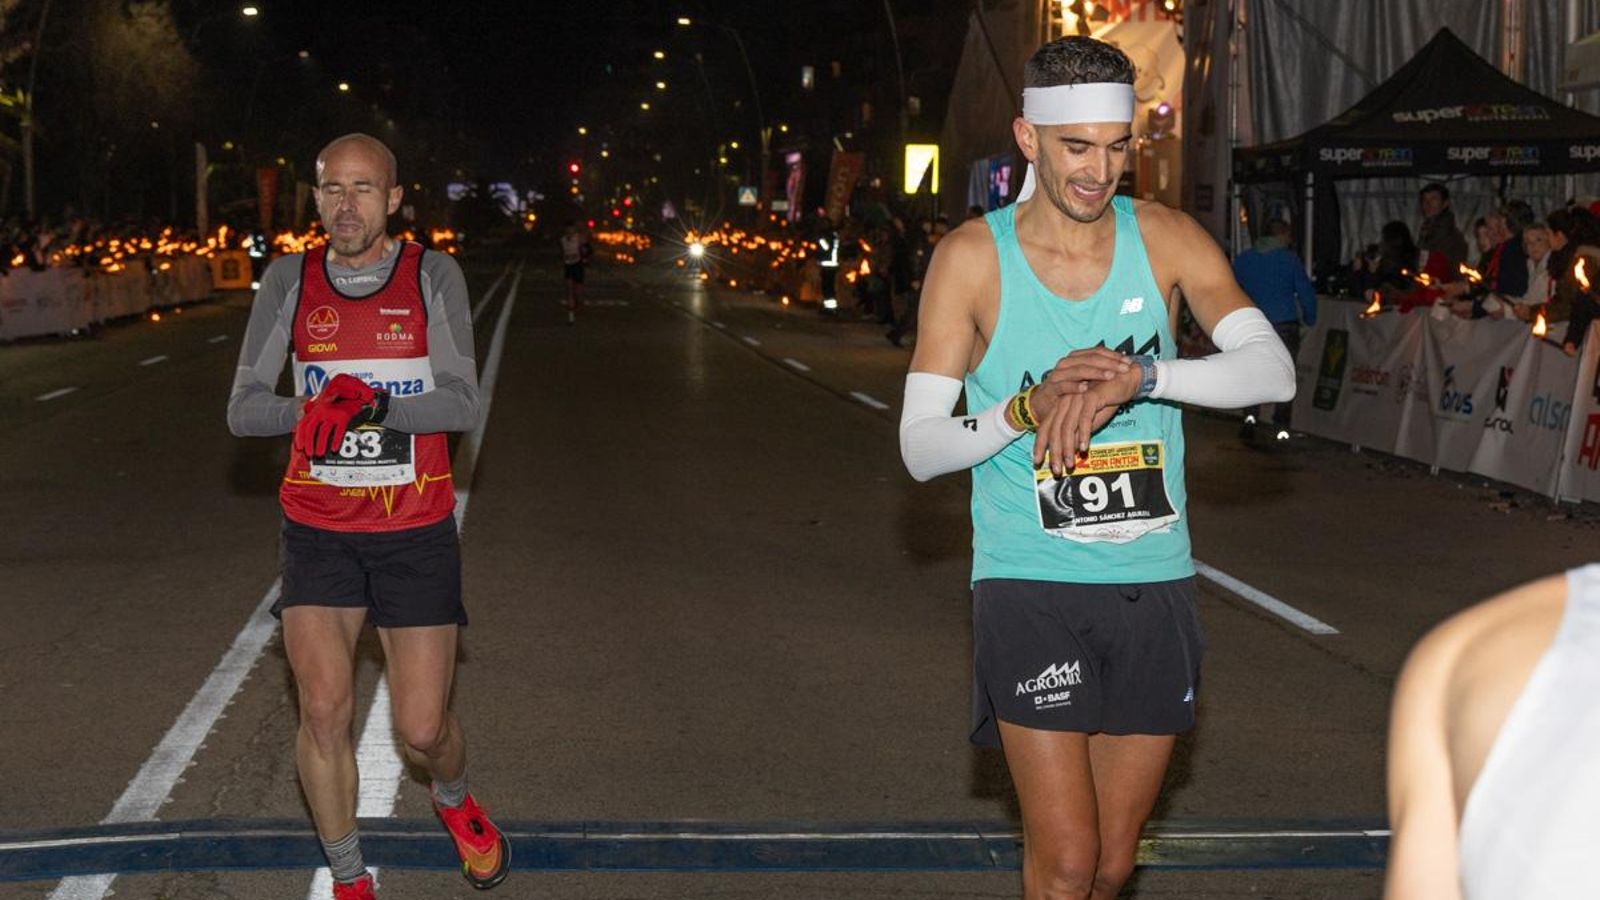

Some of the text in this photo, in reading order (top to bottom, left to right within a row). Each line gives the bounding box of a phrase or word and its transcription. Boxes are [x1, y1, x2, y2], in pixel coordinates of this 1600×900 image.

[308, 343, 338, 352] GIOVA
[340, 431, 382, 458] 83
[1079, 473, 1135, 512] 91
[1072, 516, 1098, 524] ANTONIO
[1016, 668, 1082, 696] AGROMIX
[1047, 691, 1071, 702] BASF
